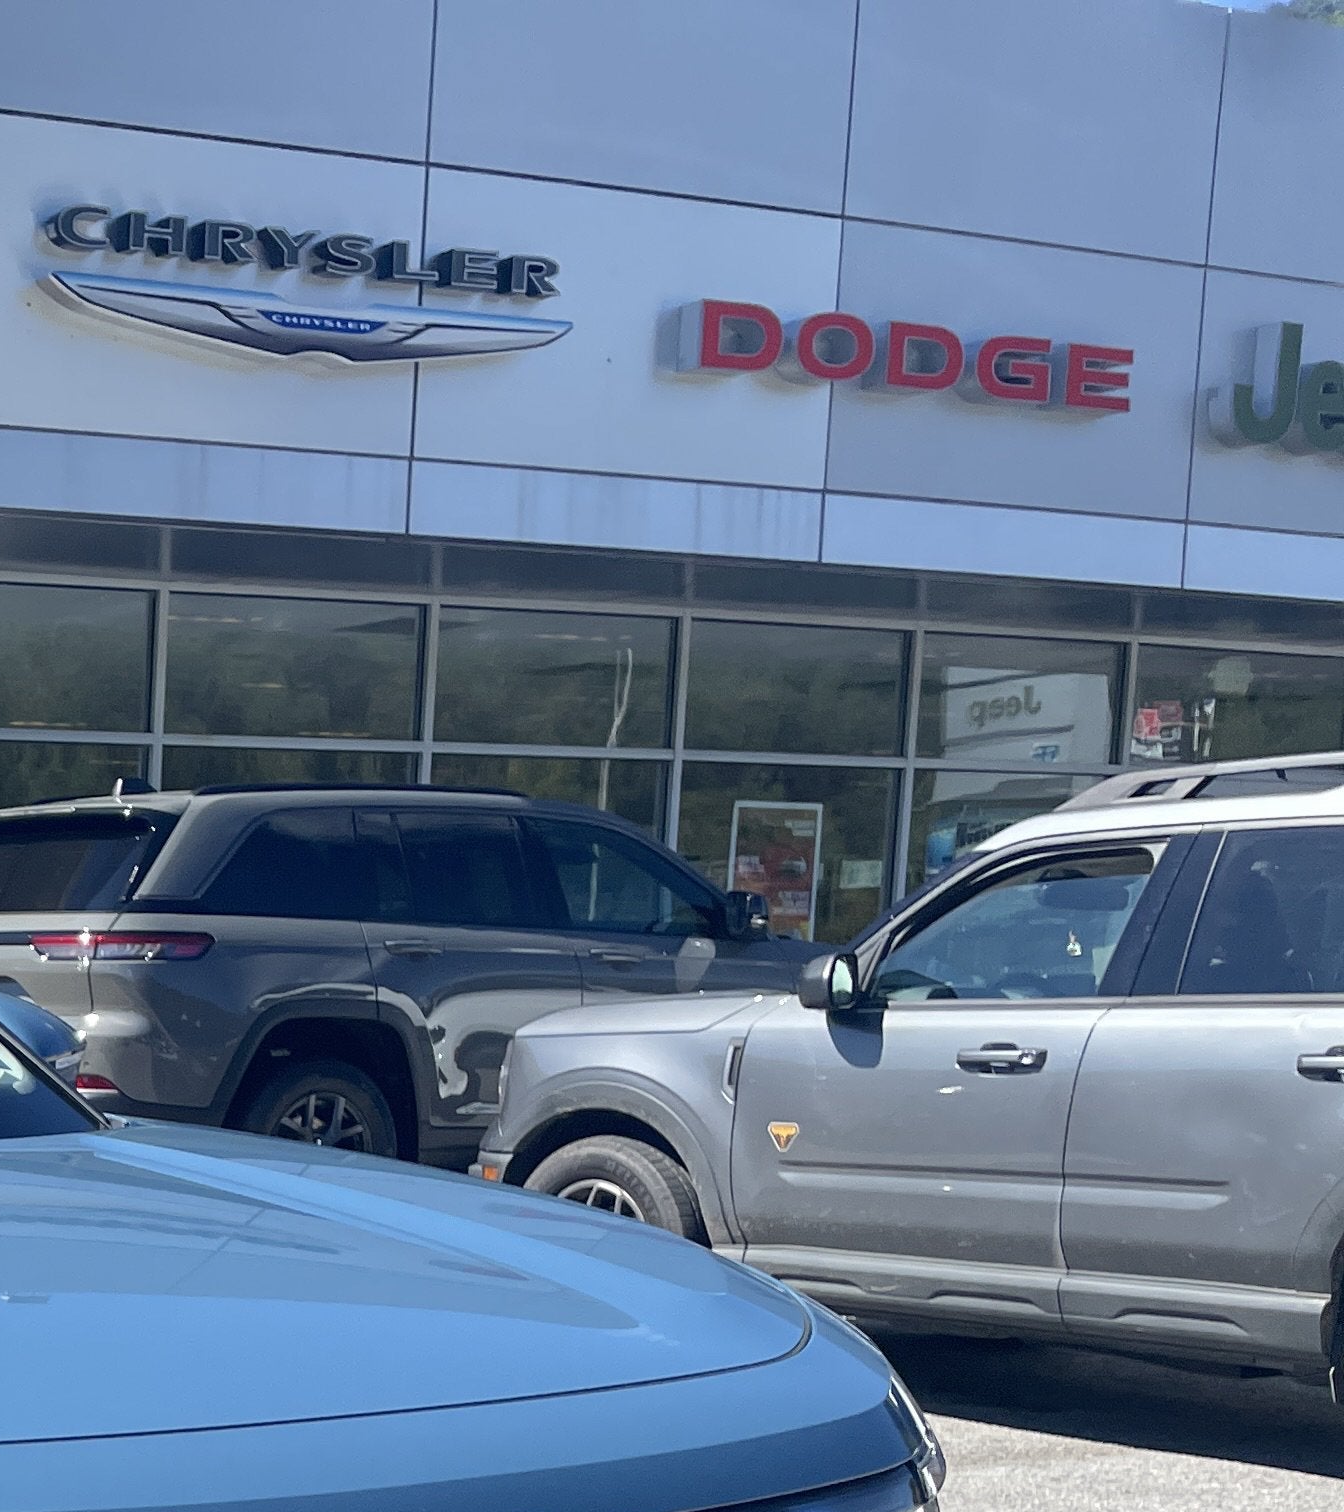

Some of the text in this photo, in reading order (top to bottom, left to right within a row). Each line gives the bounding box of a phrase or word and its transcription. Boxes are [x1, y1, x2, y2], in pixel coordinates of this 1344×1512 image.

[54, 204, 561, 297] CHRYSLER
[270, 313, 372, 332] CHRYSLER
[699, 298, 1135, 413] DODGE
